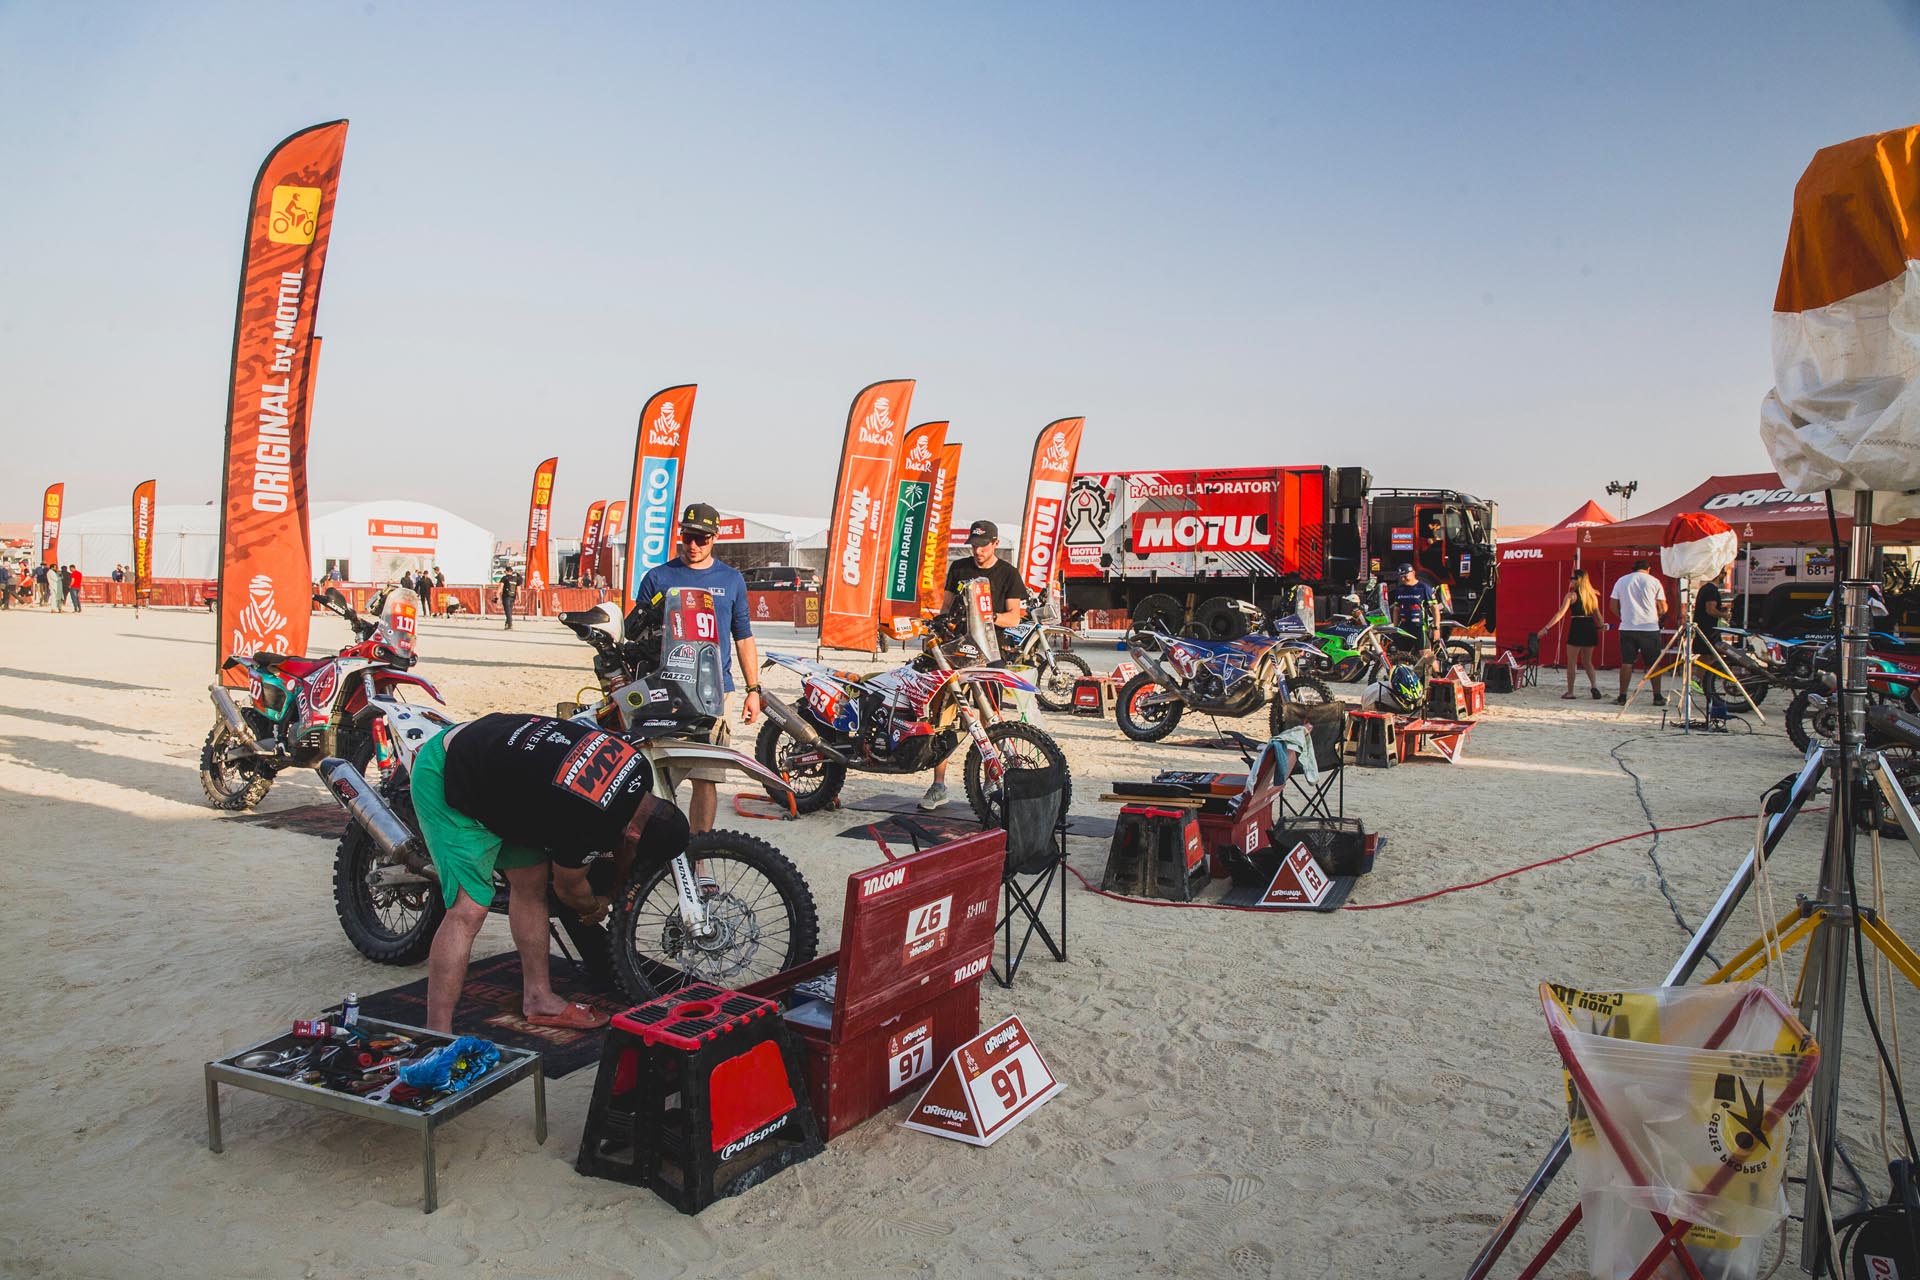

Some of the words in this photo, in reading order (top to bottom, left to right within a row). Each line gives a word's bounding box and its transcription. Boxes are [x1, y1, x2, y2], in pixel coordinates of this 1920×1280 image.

[272, 267, 304, 340] MOTUL
[270, 343, 292, 372] by
[252, 378, 291, 513] ORIGINAL
[649, 429, 681, 447] DAKAR
[859, 427, 894, 447] DAKAR
[905, 458, 932, 473] DAKAR
[1041, 457, 1069, 473] DAKAR
[1130, 484, 1183, 498] RACING
[1704, 487, 1826, 509] ORIGIN
[718, 524, 733, 535] VICE
[869, 500, 881, 532] MOTUL
[842, 487, 871, 587] ORIGINAL
[900, 516, 914, 558] ARABIA
[1139, 514, 1273, 548] MOTUL
[1029, 503, 1057, 589] MOTUL
[1071, 548, 1100, 556] MOTUL
[1503, 549, 1543, 560] MOTUL
[896, 558, 909, 592] SAUDI
[1807, 566, 1828, 576] 681
[979, 596, 992, 612] 63
[696, 612, 715, 638] 97
[661, 672, 691, 680] RAZZO
[809, 687, 831, 713] 63
[524, 720, 559, 751] RAINER
[584, 733, 609, 757] DAKAR
[563, 754, 588, 786] TEAM
[575, 738, 625, 794] KTM
[676, 858, 694, 904] DUNLOP
[863, 867, 906, 896] MOTUL
[1305, 866, 1322, 891] 63
[914, 903, 942, 937] 97
[953, 955, 990, 983] MOTUL
[902, 1024, 928, 1045] ORIGINAL
[984, 1023, 1019, 1055] ORIGINAL
[899, 1045, 925, 1081] 97
[991, 1058, 1027, 1110] 97
[922, 1104, 968, 1122] ORIGINAL
[721, 1115, 788, 1160] Polisport
